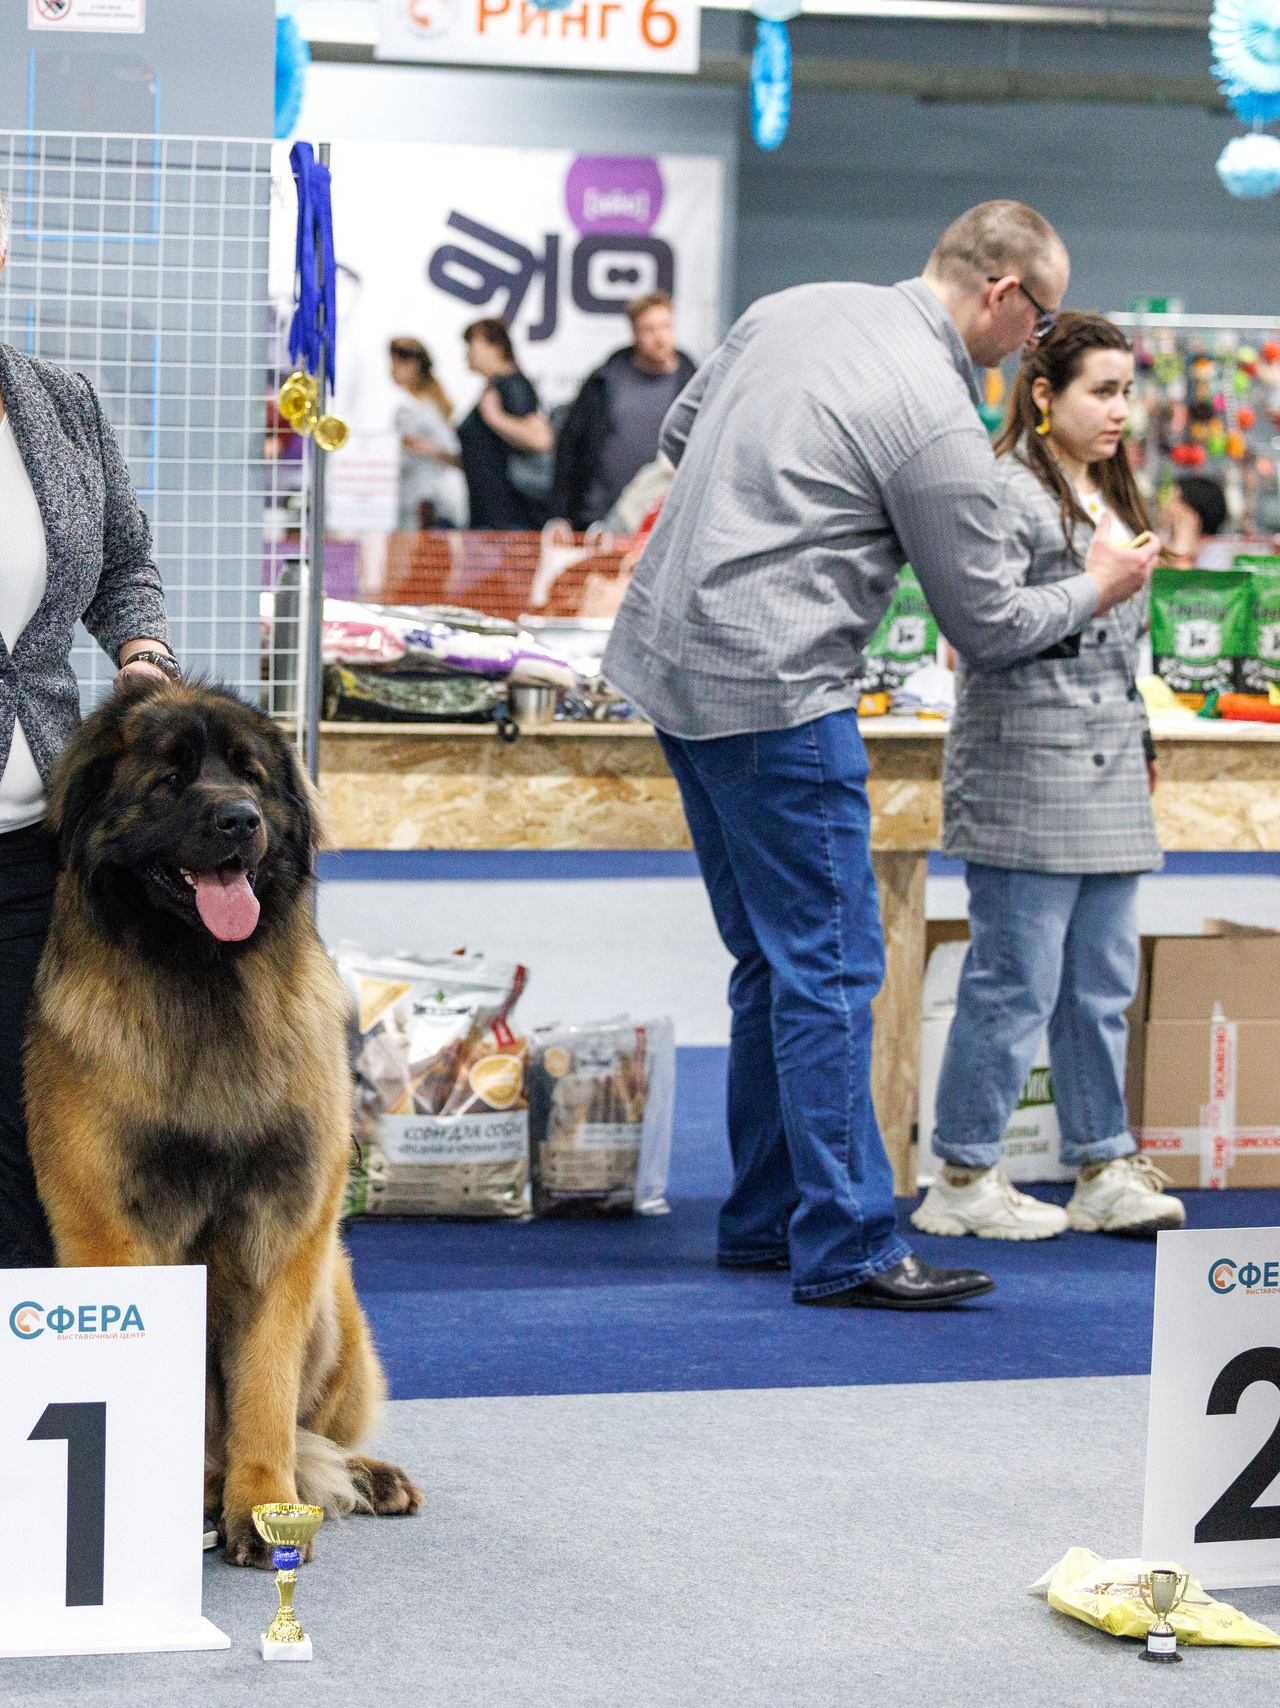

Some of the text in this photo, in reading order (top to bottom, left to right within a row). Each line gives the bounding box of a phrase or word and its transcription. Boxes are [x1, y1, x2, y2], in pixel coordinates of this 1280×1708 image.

[641, 0, 678, 48] 6
[9, 1301, 146, 1340] СФЕРА
[57, 1332, 146, 1341] ВЫСТАВОЧНЫЙ ЦЕНТР
[1194, 1347, 1280, 1544] 2
[26, 1401, 107, 1607] 1
